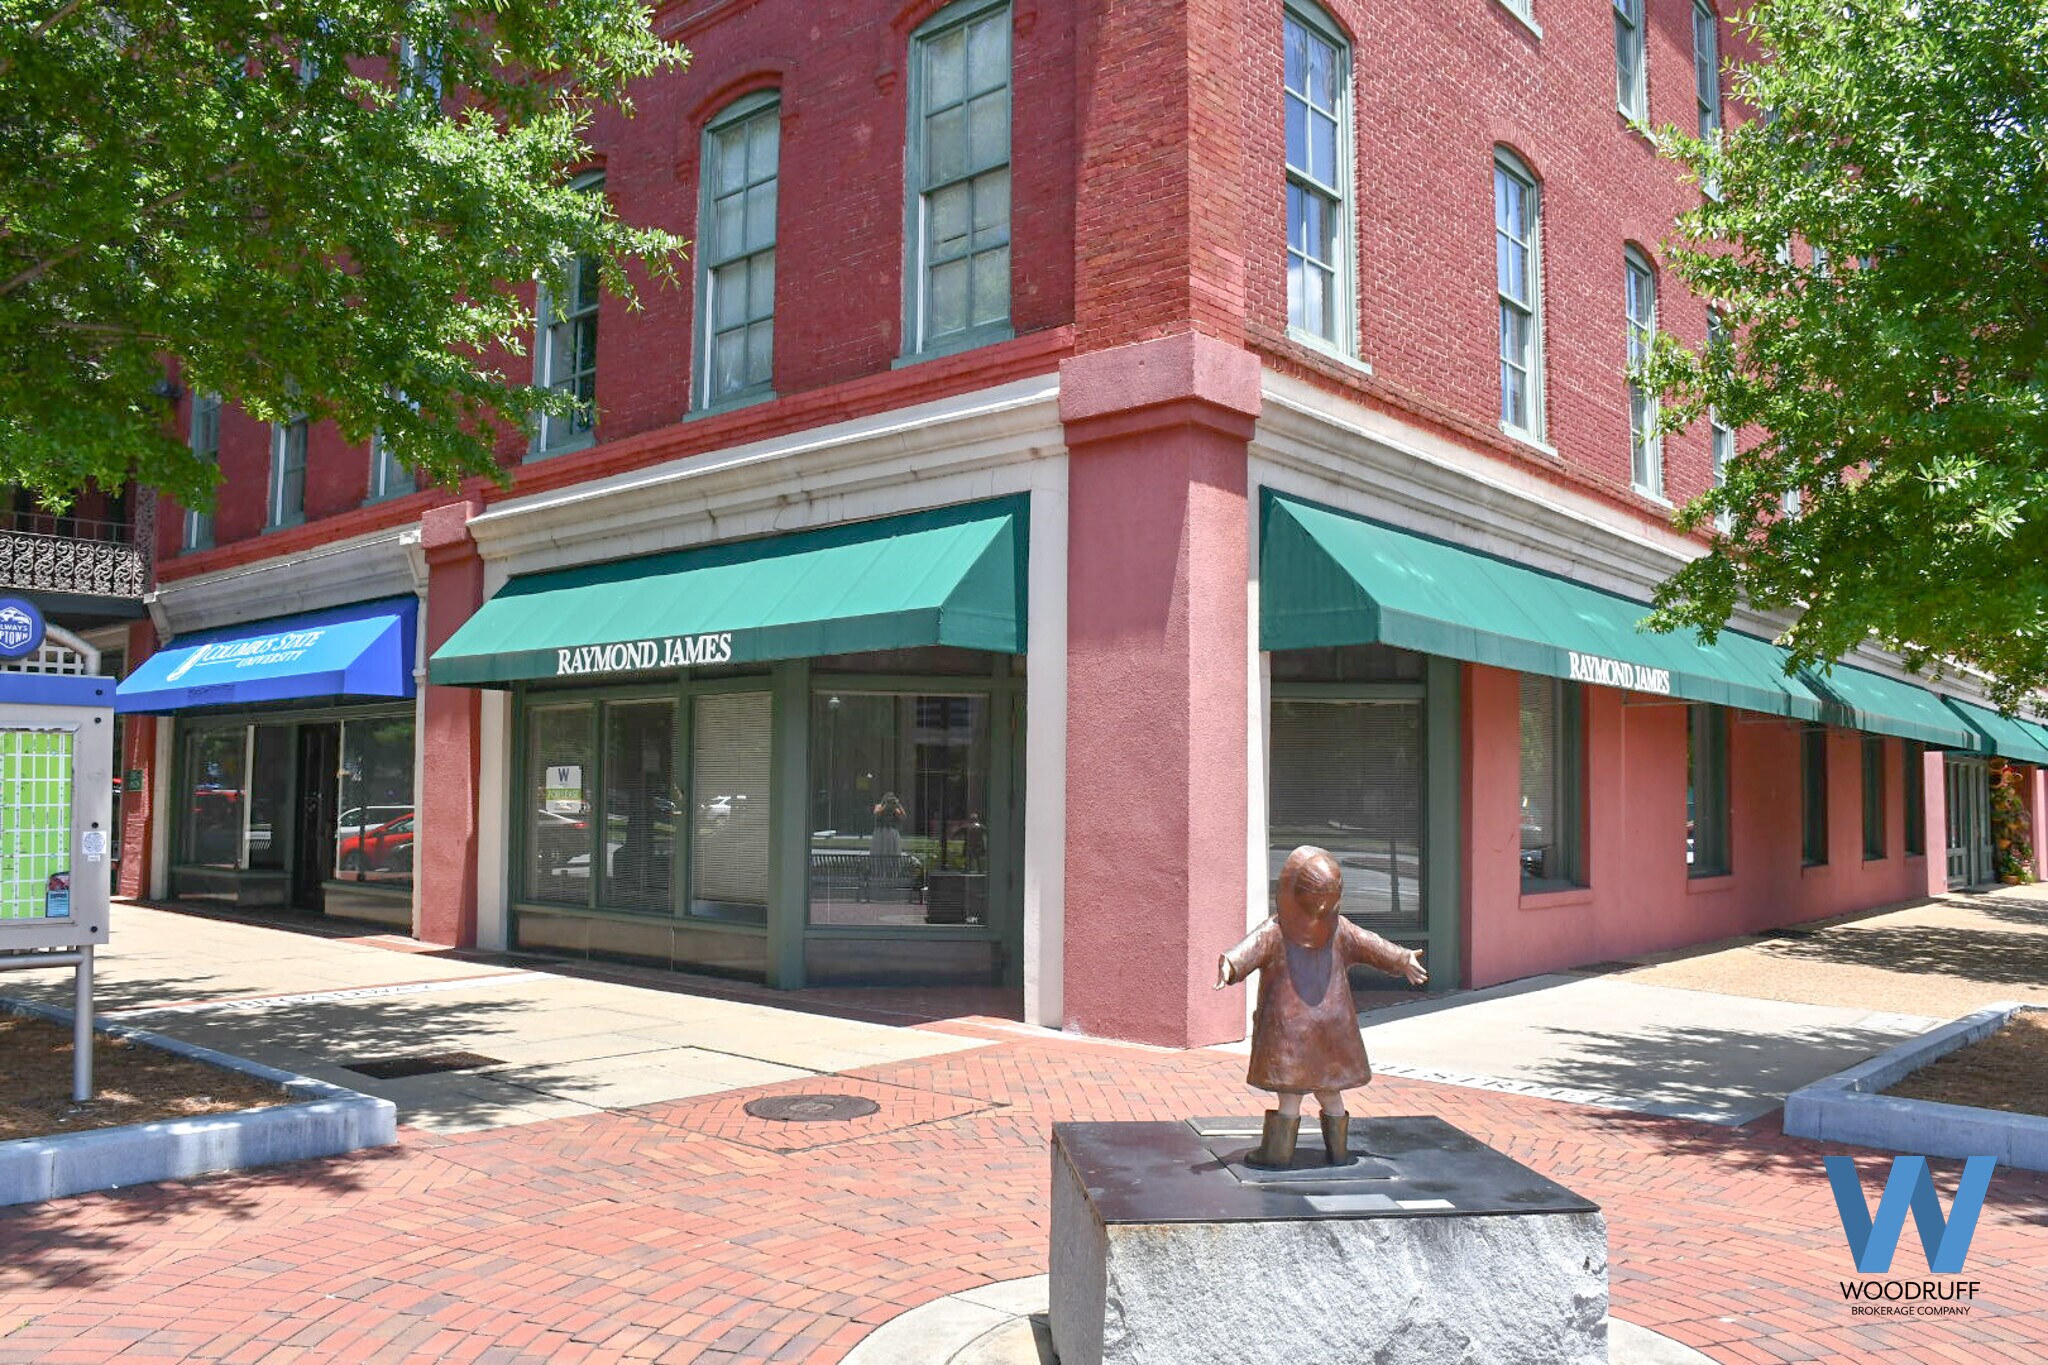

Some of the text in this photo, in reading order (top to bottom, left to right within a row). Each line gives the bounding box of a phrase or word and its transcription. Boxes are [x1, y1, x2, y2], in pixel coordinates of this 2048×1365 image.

[0, 624, 28, 632] LWAYS
[0, 631, 29, 645] PTOWN
[202, 630, 326, 662] COLUMBUS STATE
[236, 649, 307, 668] UNIVERSITY
[557, 632, 732, 675] RAYMOND JAMES
[1568, 651, 1670, 694] RAYMOND JAMES
